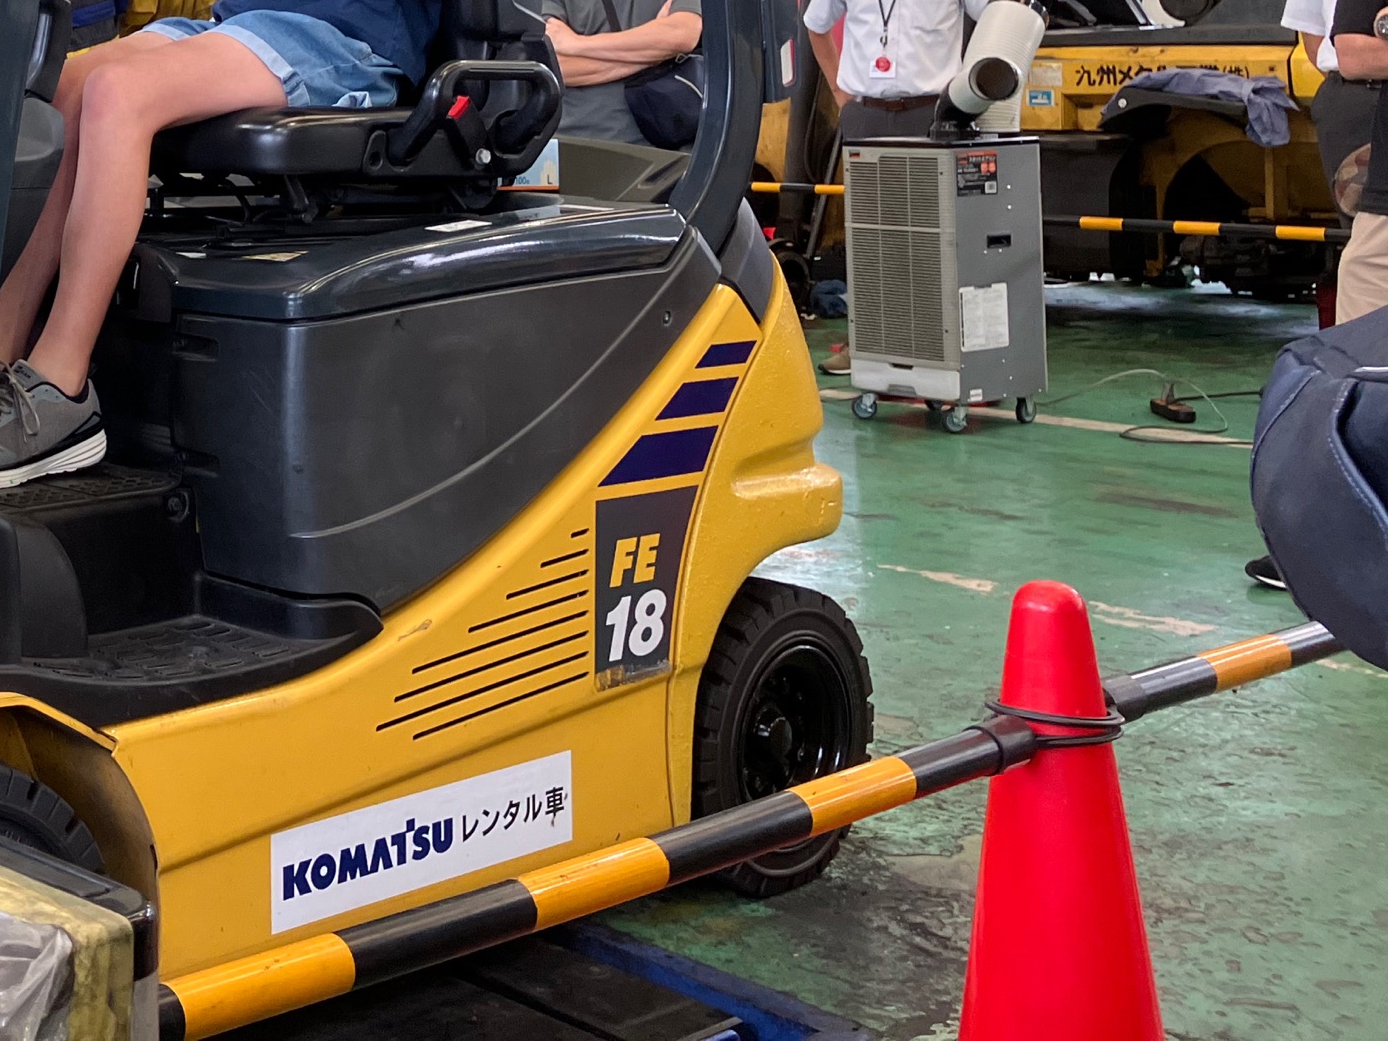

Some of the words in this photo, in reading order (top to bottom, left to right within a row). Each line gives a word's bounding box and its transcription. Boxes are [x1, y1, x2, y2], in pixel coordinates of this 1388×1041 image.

[609, 533, 661, 588] FE
[605, 589, 667, 662] 18
[282, 818, 454, 902] KOMATSU
[463, 786, 565, 842] レンタル車
